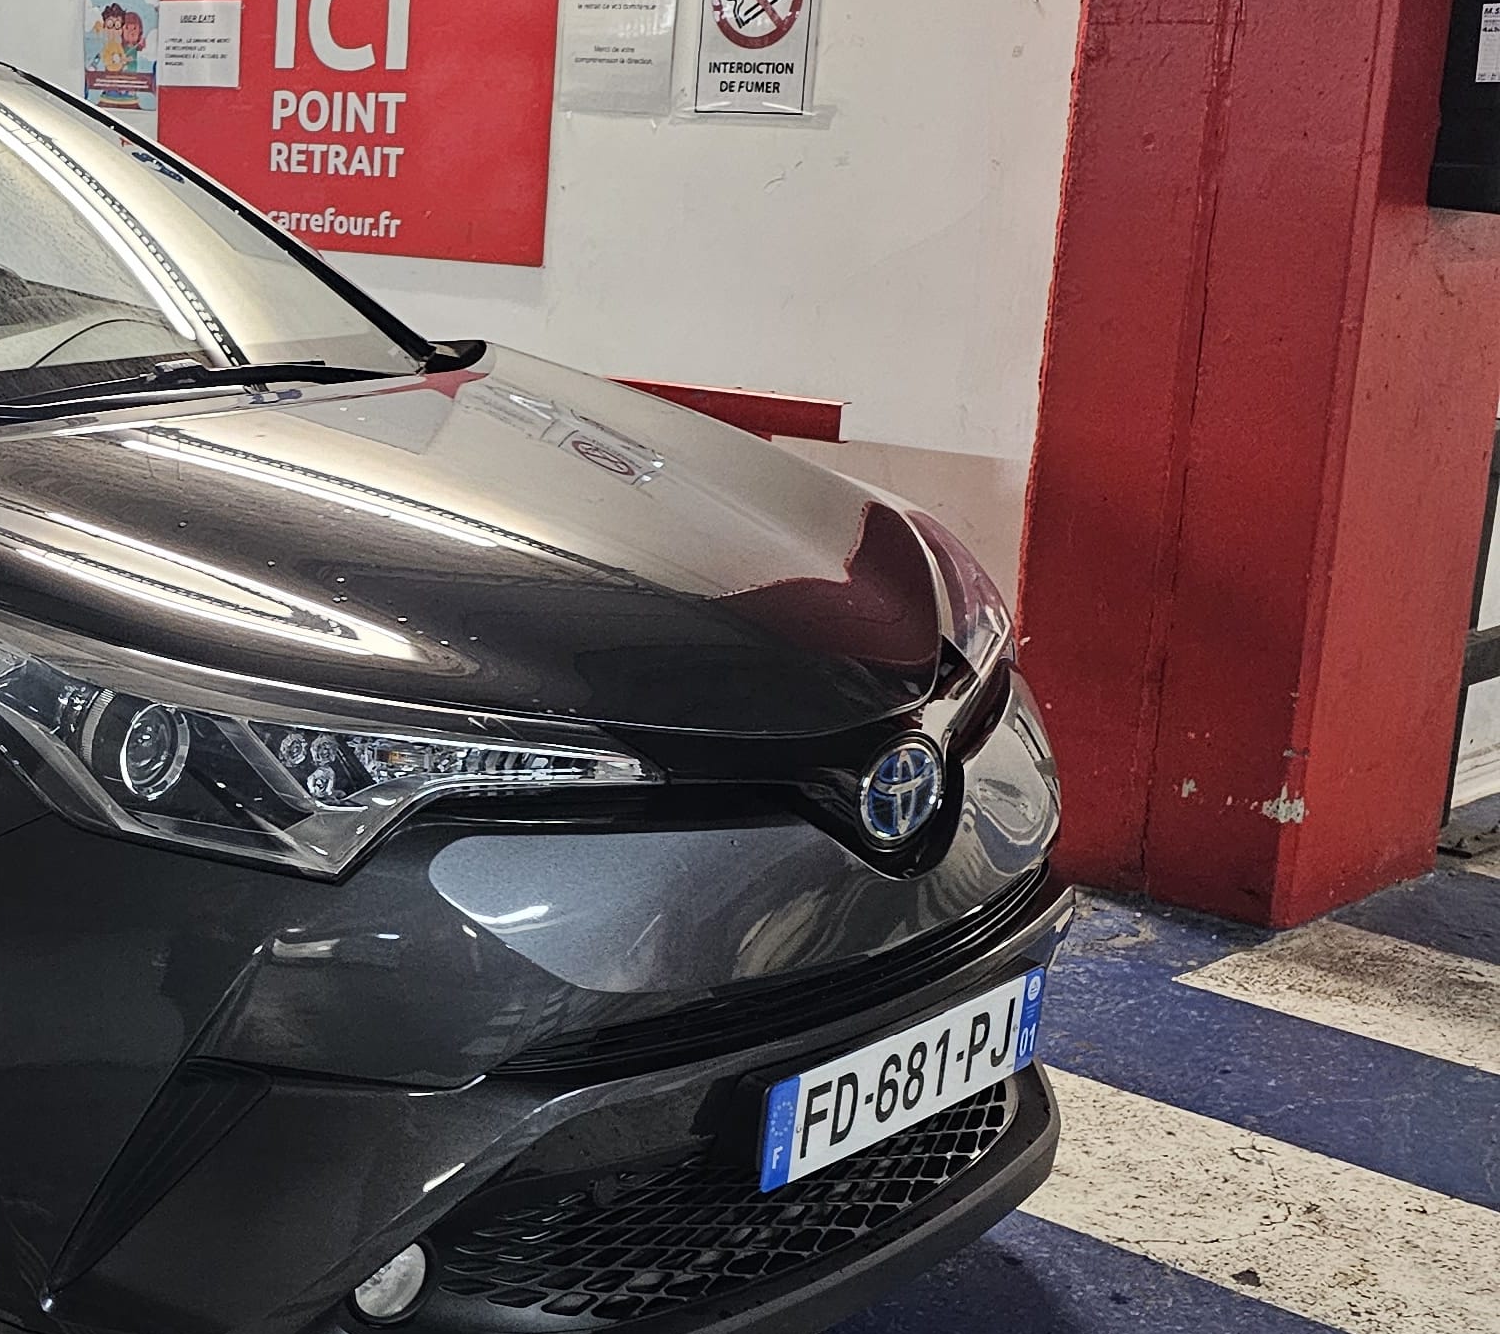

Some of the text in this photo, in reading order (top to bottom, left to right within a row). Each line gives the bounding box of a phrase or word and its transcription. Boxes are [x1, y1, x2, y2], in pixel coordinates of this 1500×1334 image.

[708, 62, 794, 74] INTERDICTION
[719, 81, 780, 93] DE FUMER
[272, 90, 406, 134] POINT
[270, 142, 404, 178] RETRAIT
[771, 1145, 783, 1169] F
[799, 997, 1016, 1159] FD-681-PJ
[1019, 1023, 1037, 1056] 01
